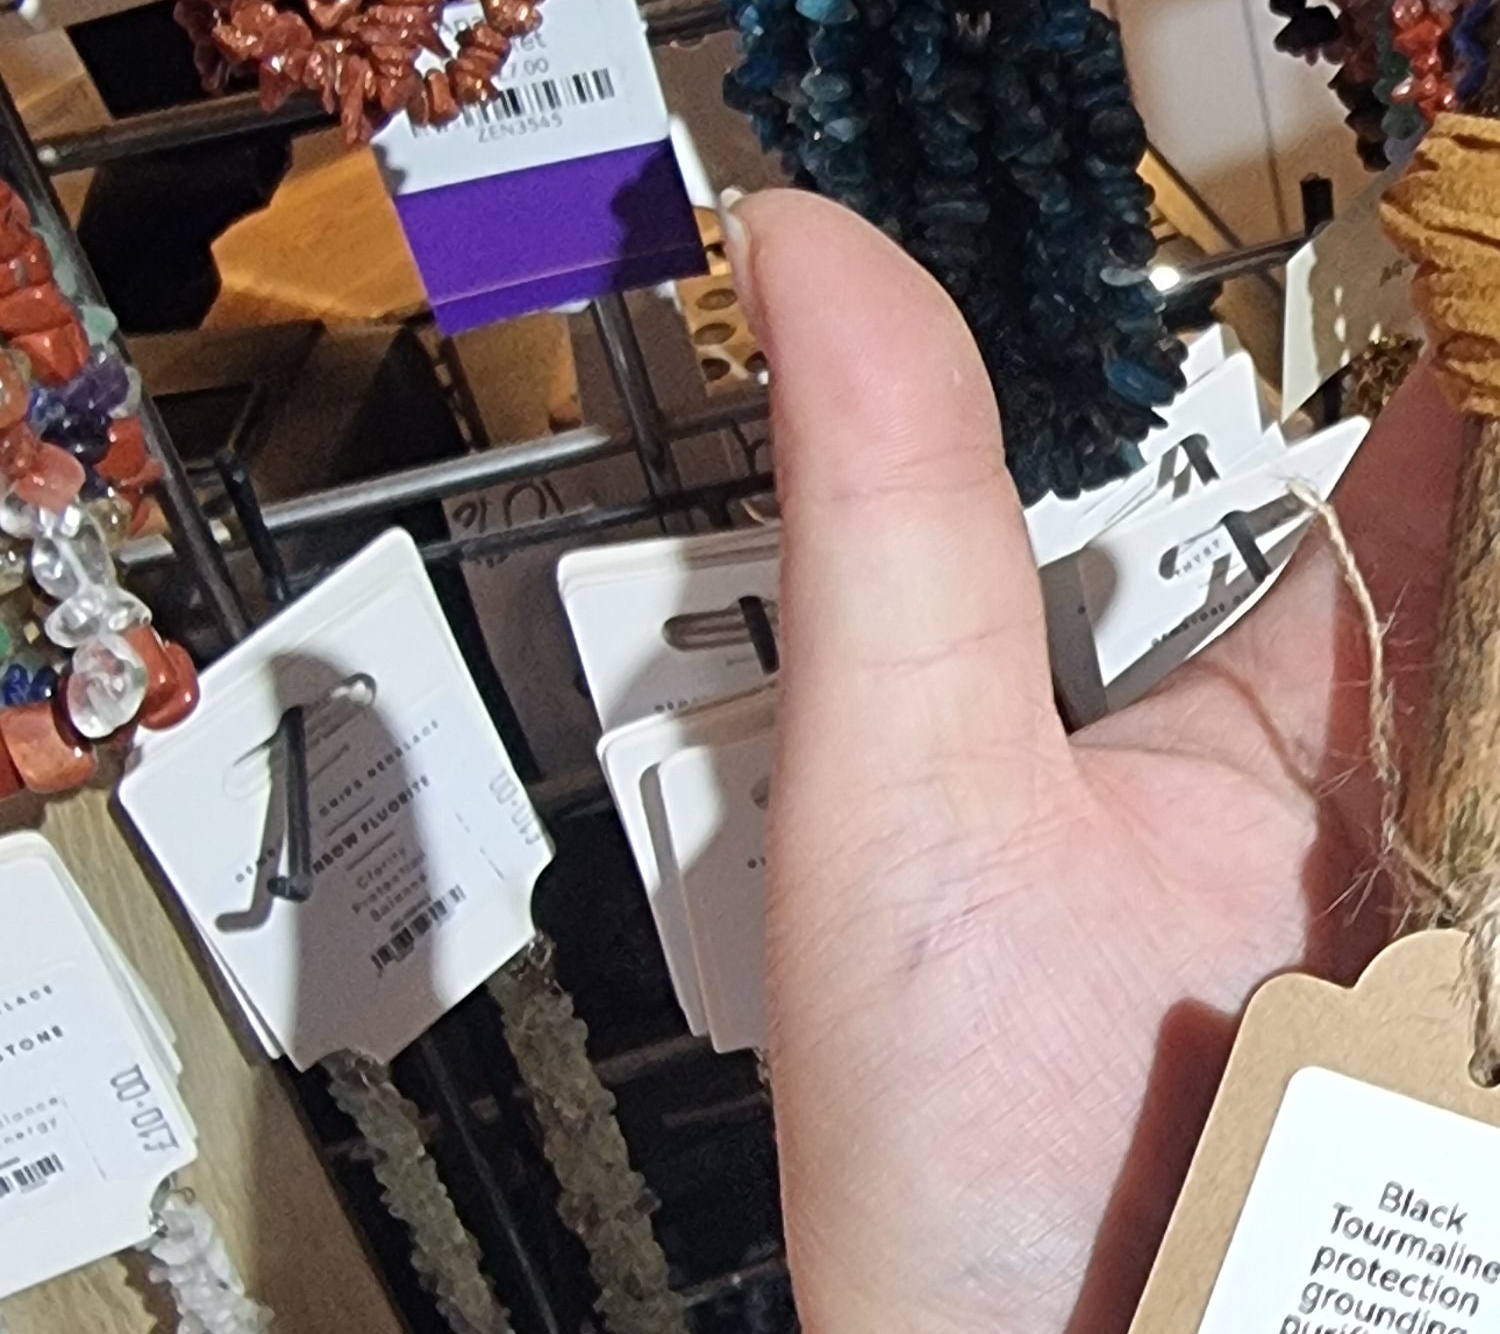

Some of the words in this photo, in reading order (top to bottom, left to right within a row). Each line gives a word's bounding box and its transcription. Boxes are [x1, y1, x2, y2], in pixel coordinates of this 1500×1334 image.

[360, 775, 430, 835] FLUORITE
[0, 1025, 63, 1063] TONE
[1377, 1180, 1468, 1235] Black
[1310, 1245, 1480, 1317] protection
